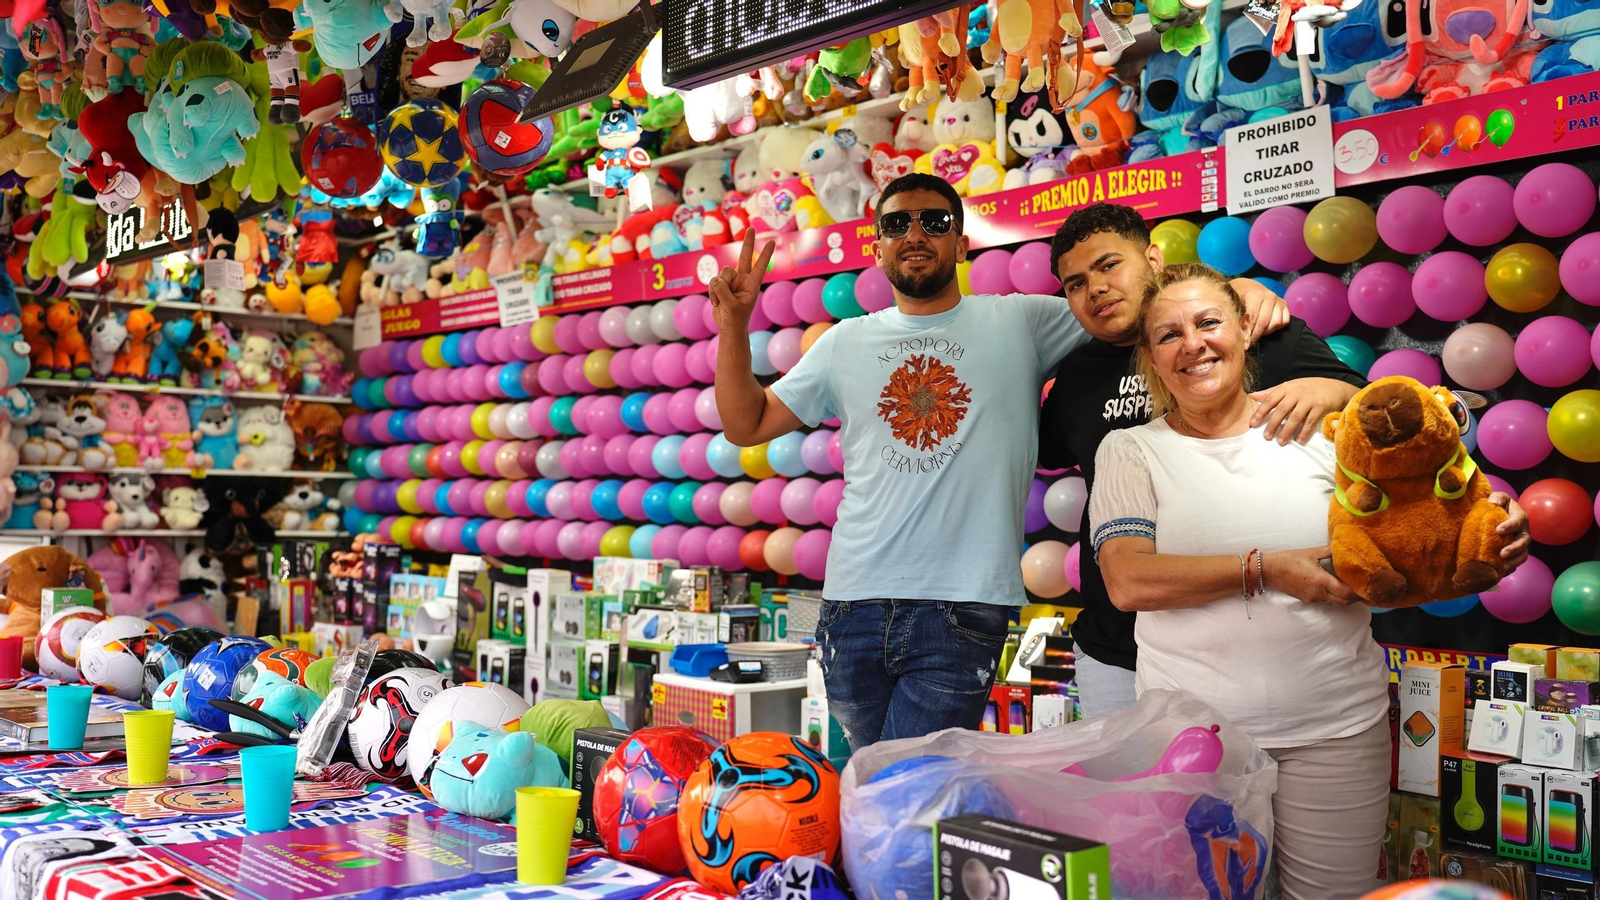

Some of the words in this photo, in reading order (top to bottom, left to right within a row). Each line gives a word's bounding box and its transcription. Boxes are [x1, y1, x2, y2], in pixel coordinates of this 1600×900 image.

[1556, 95, 1563, 111] 1
[1238, 115, 1316, 142] PROHIBIDO
[1256, 141, 1299, 160] TIRAR
[1244, 160, 1313, 183] CRUZADO
[1032, 177, 1089, 214] PREMIO
[1093, 174, 1105, 202] A
[1108, 169, 1167, 200] ELEGIR
[1255, 185, 1279, 195] DARDO
[1294, 179, 1314, 188] SERA
[1239, 199, 1265, 208] VALIDO
[1268, 194, 1289, 204] COMO
[1291, 188, 1320, 199] PREMIO
[651, 263, 665, 291] 3
[878, 337, 965, 368] ACROPORA
[1119, 374, 1149, 397] USU
[1102, 394, 1154, 421] SUSPE
[1409, 687, 1431, 696] JUICE
[1411, 680, 1430, 689] MINI
[576, 739, 597, 750] PISTOLA
[597, 743, 605, 751] DE
[604, 745, 616, 753] MAS
[1444, 760, 1457, 768] P47
[940, 832, 970, 848] PISTOLA
[970, 841, 980, 851] DE
[980, 842, 1012, 861] MASAJE
[1467, 841, 1491, 850] Headphone
